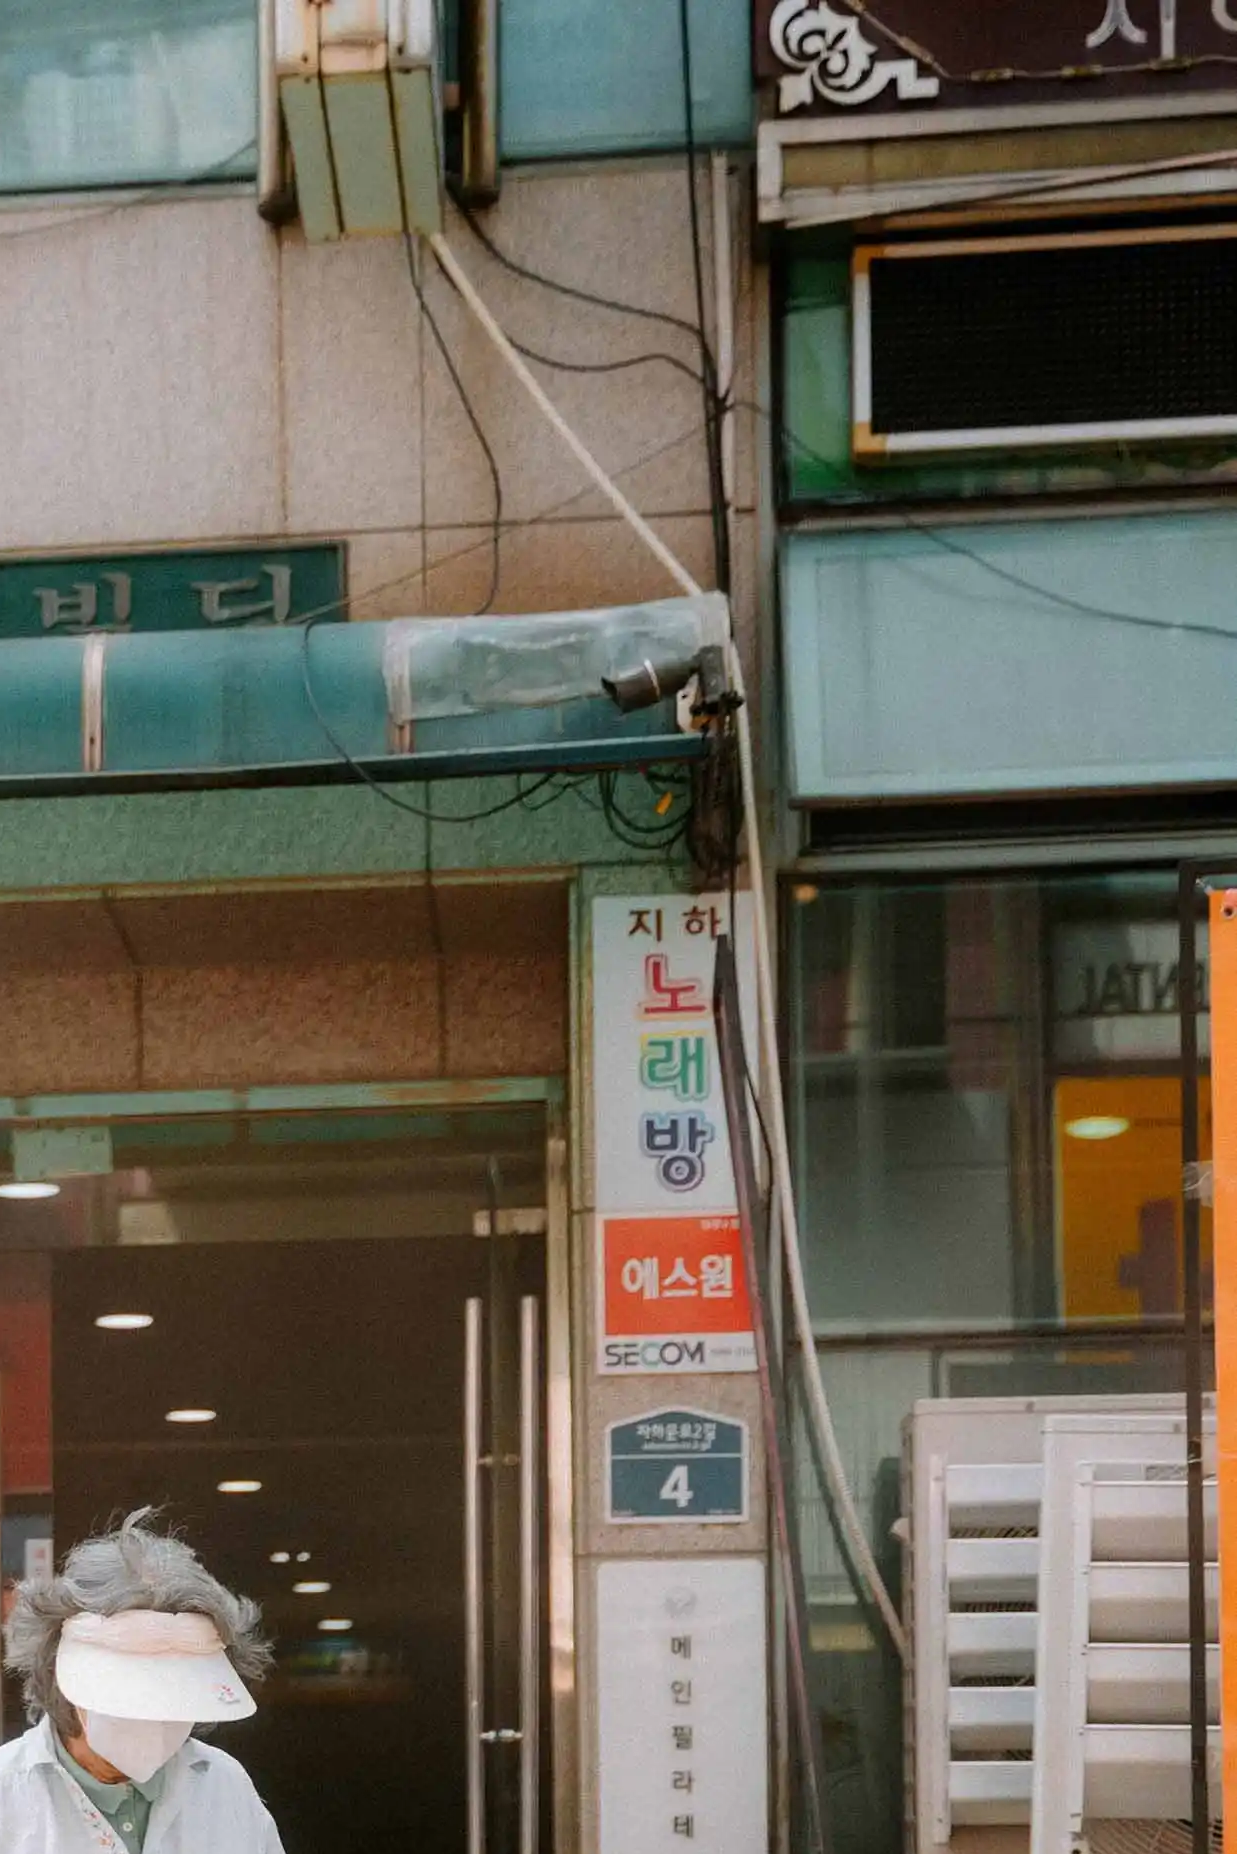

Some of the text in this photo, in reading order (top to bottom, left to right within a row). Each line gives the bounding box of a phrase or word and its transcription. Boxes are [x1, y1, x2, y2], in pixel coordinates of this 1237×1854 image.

[628, 905, 721, 942] 지하
[640, 956, 714, 1189] 노래방
[621, 1253, 733, 1299] 에스원
[604, 1340, 705, 1367] SECOM
[659, 1464, 694, 1508] 4
